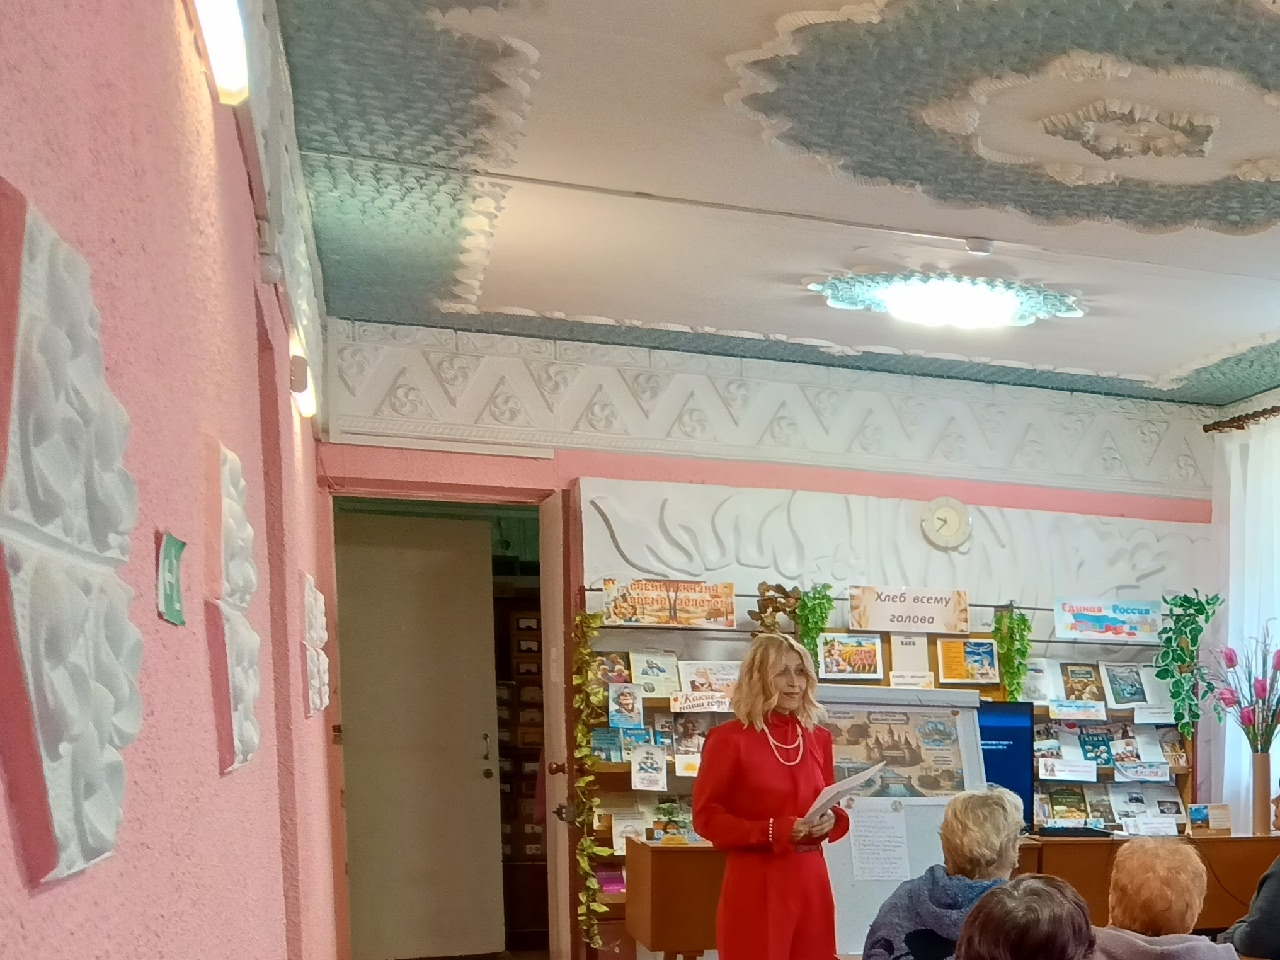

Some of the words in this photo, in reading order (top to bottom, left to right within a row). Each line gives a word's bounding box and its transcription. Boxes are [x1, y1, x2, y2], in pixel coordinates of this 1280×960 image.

[875, 591, 907, 603] Хлеб
[912, 597, 951, 607] всему
[1061, 603, 1103, 614] Единая
[1112, 604, 1150, 615] Россия
[889, 614, 935, 625] голова
